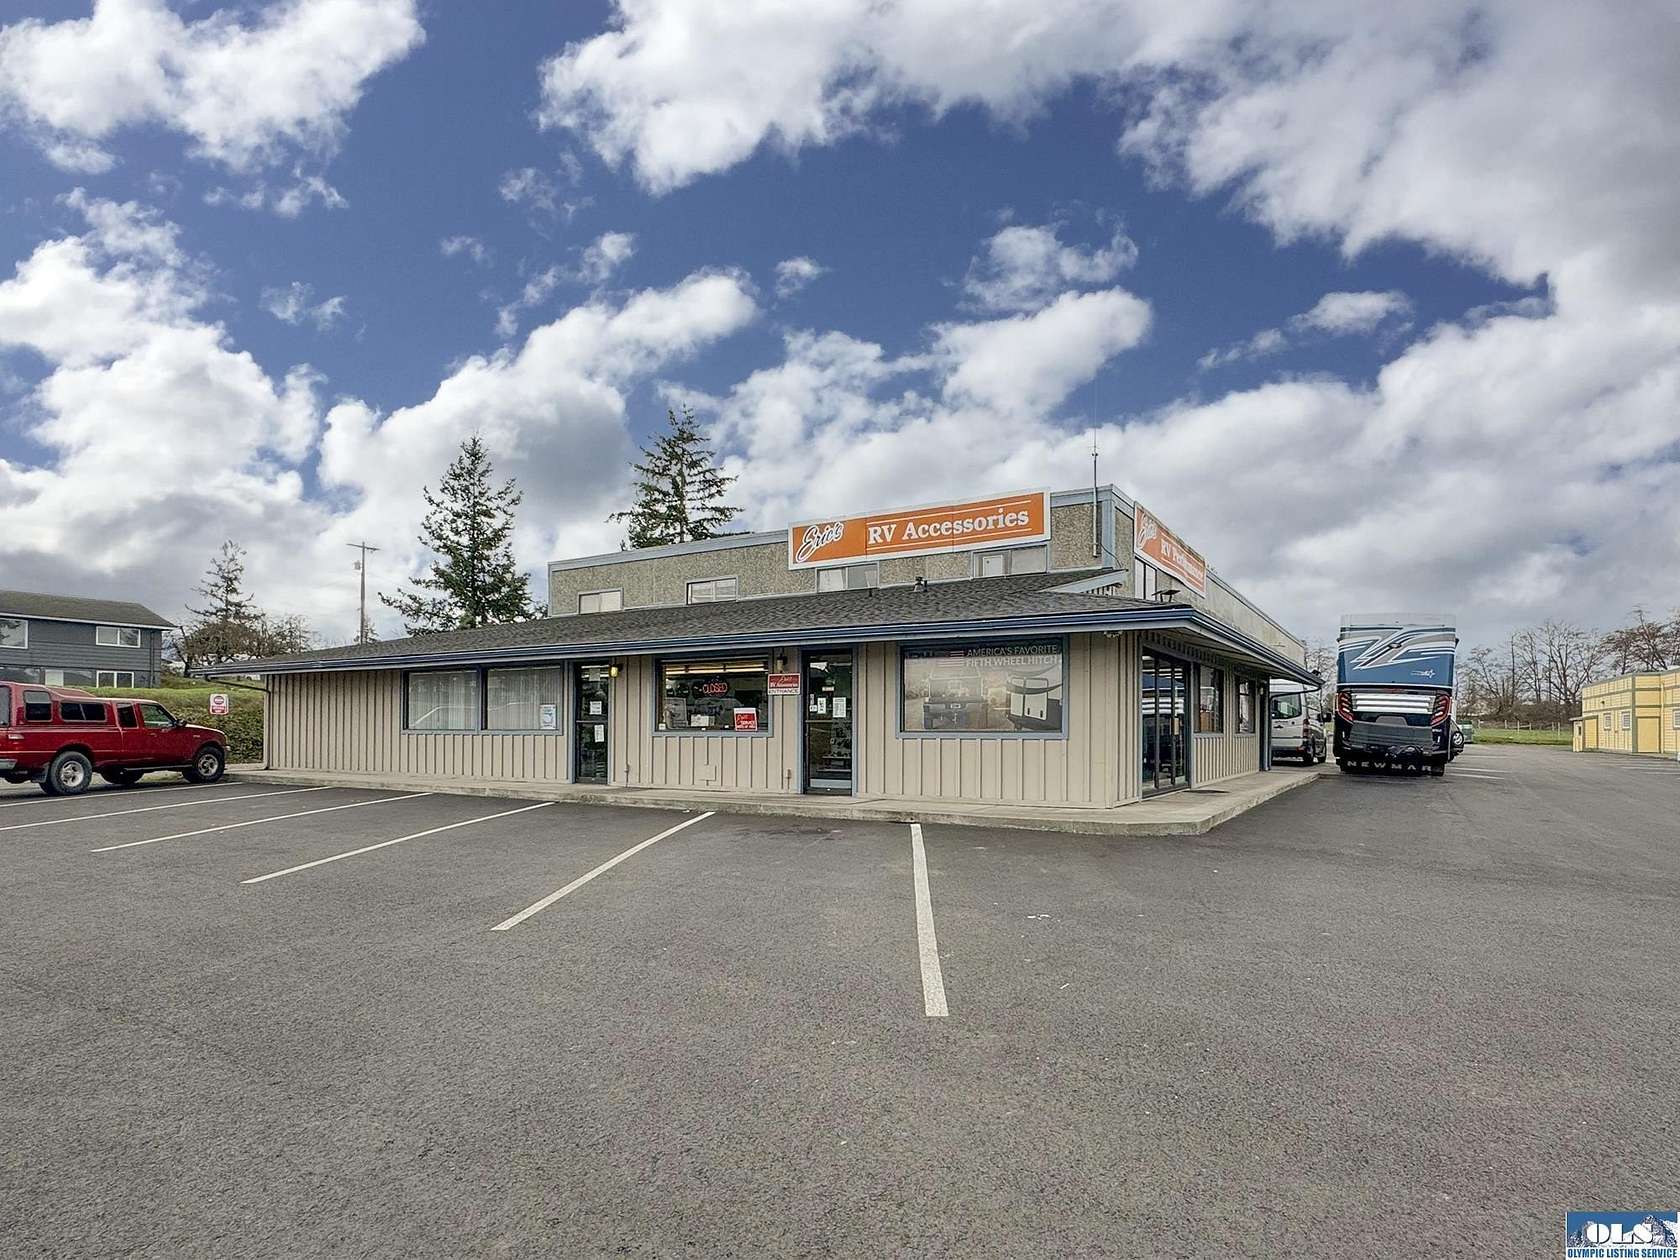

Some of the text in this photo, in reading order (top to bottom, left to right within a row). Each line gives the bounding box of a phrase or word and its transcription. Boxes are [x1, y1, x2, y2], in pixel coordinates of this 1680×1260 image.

[796, 508, 1029, 562] Eric's RV Accessories
[967, 645, 1058, 658] AMERICA'S FAVORITE
[966, 655, 1057, 667] FIFTH WHEEL HITCH
[702, 682, 728, 694] CLOSED
[1347, 760, 1432, 772] NEWMAR
